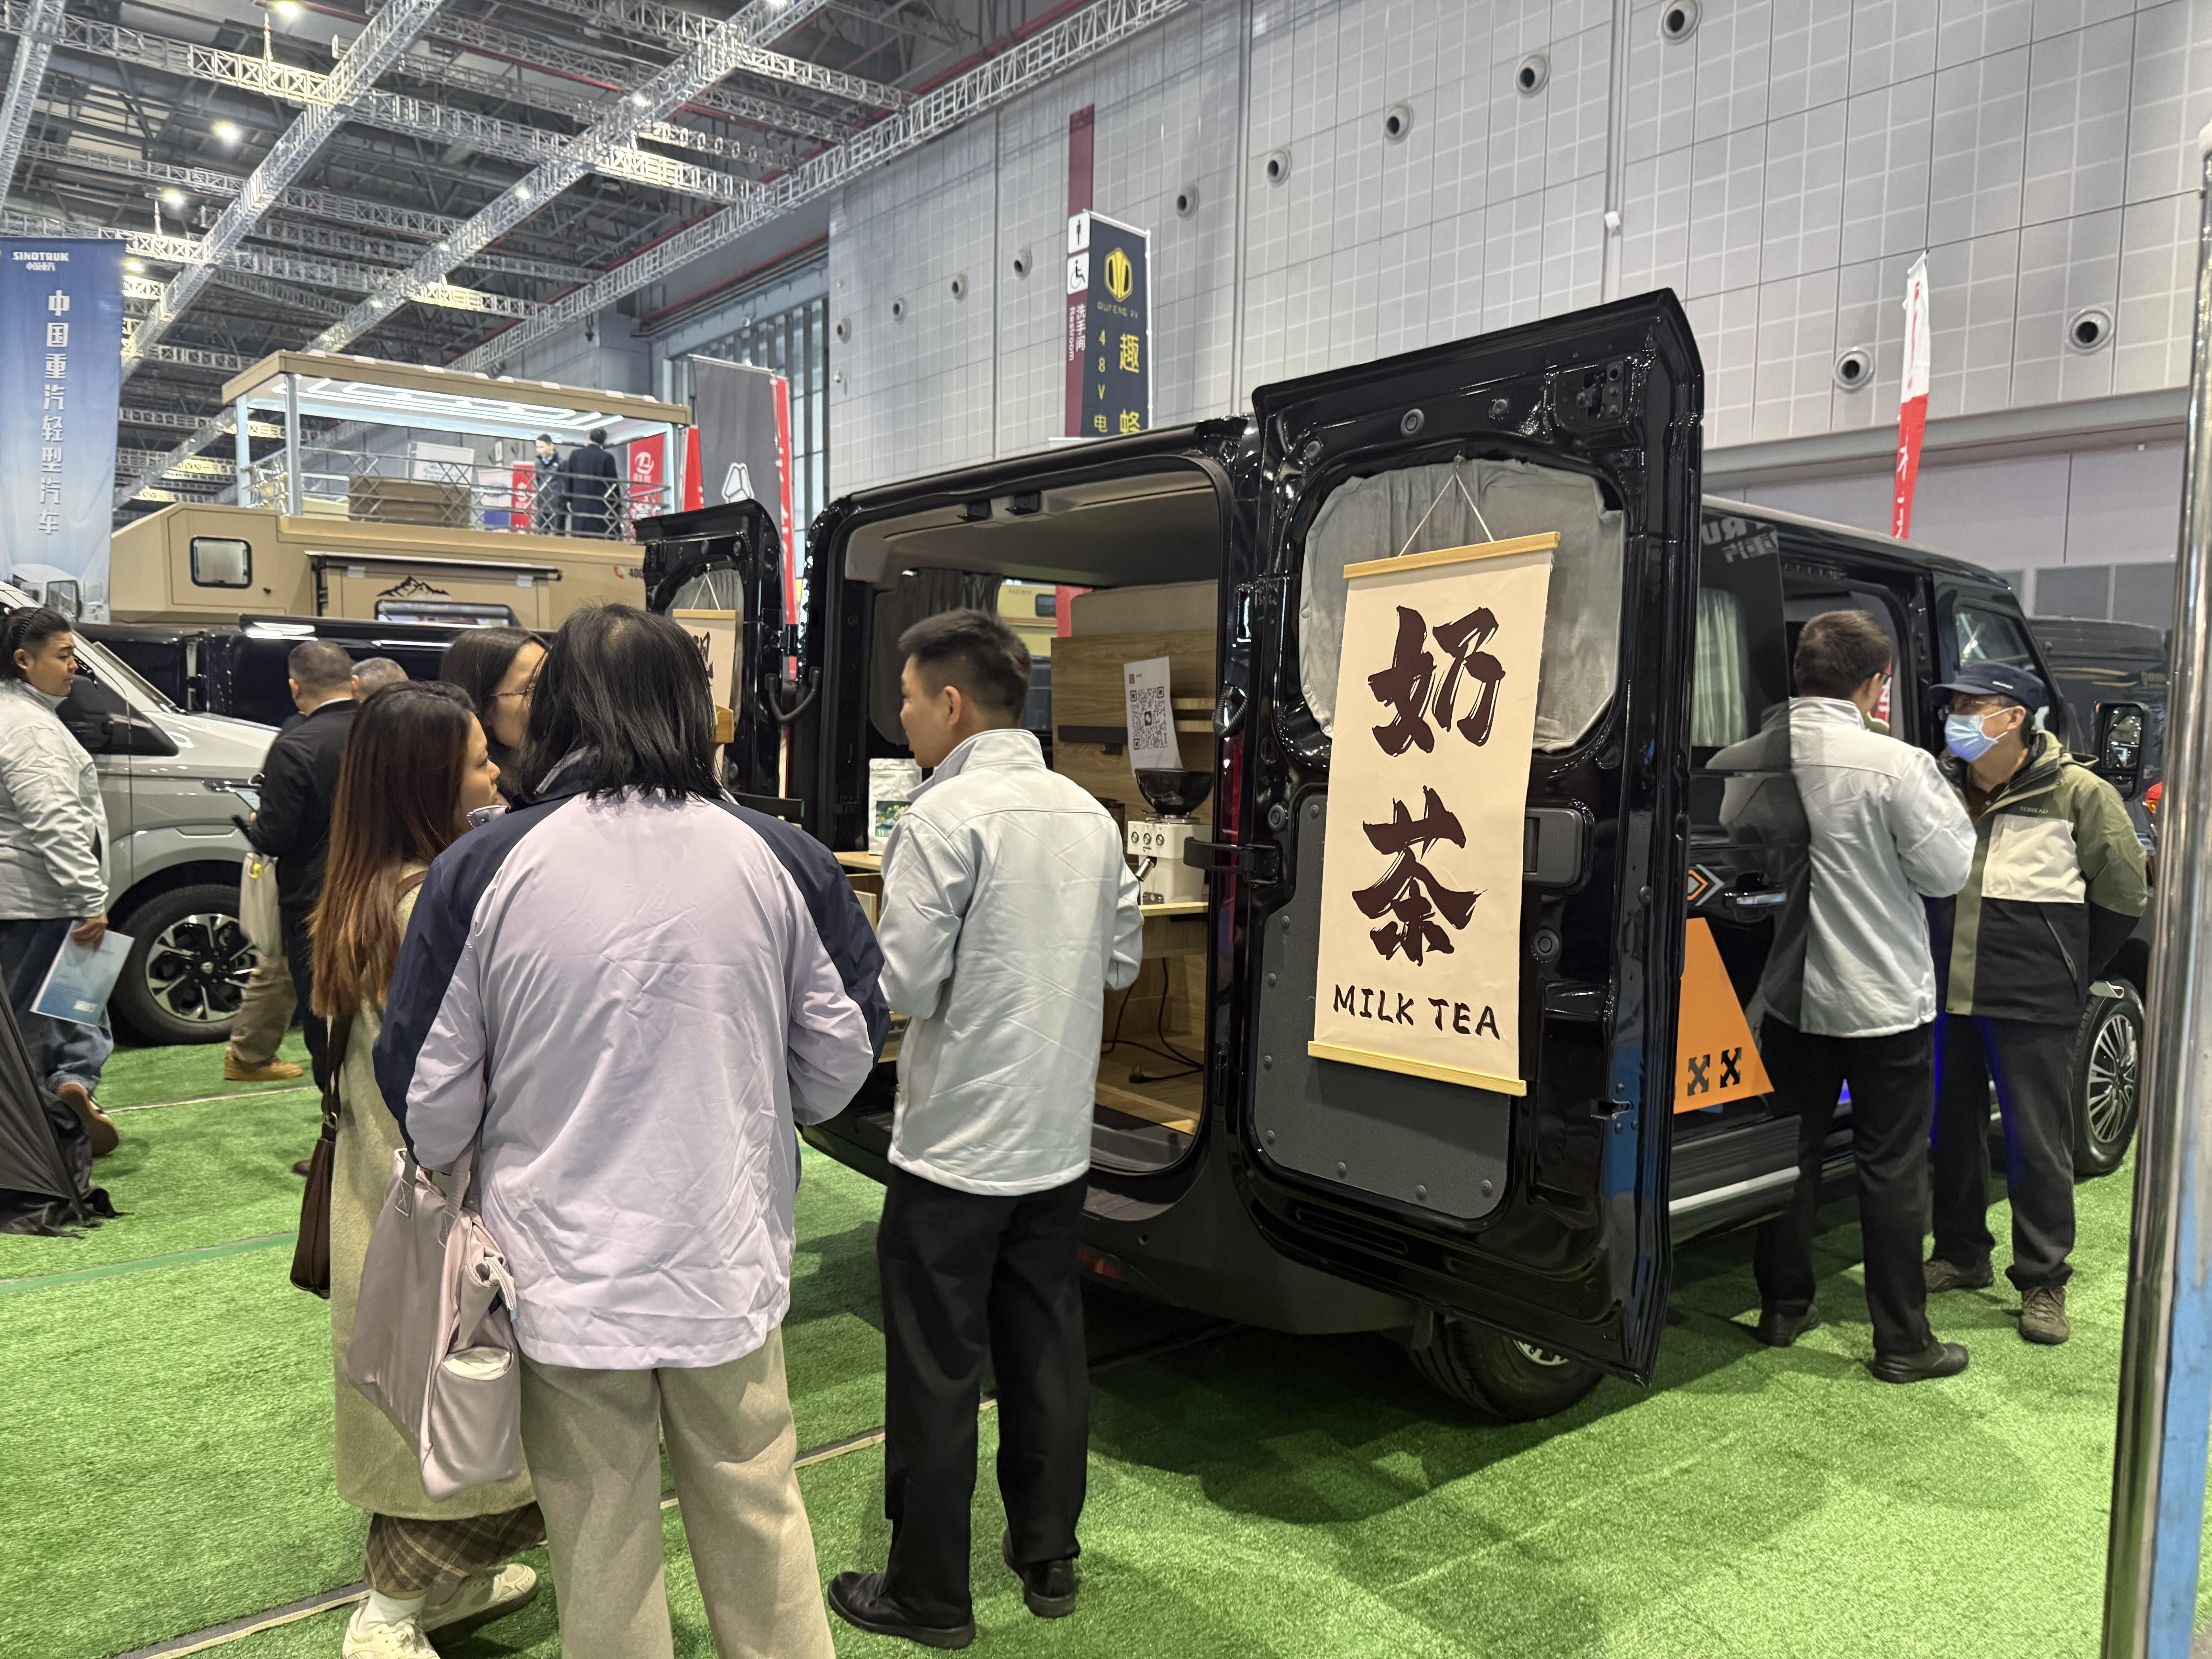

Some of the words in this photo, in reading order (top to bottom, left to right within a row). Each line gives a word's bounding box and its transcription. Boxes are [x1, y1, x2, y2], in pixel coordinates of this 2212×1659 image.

[12, 252, 69, 261] SINOTRUK
[1075, 303, 1086, 352] 洗手间
[38, 290, 70, 535] 中国重汽轻型汽车
[1352, 605, 1506, 967] 奶茶
[1333, 983, 1415, 1028] MILK
[1429, 998, 1501, 1041] TEA
